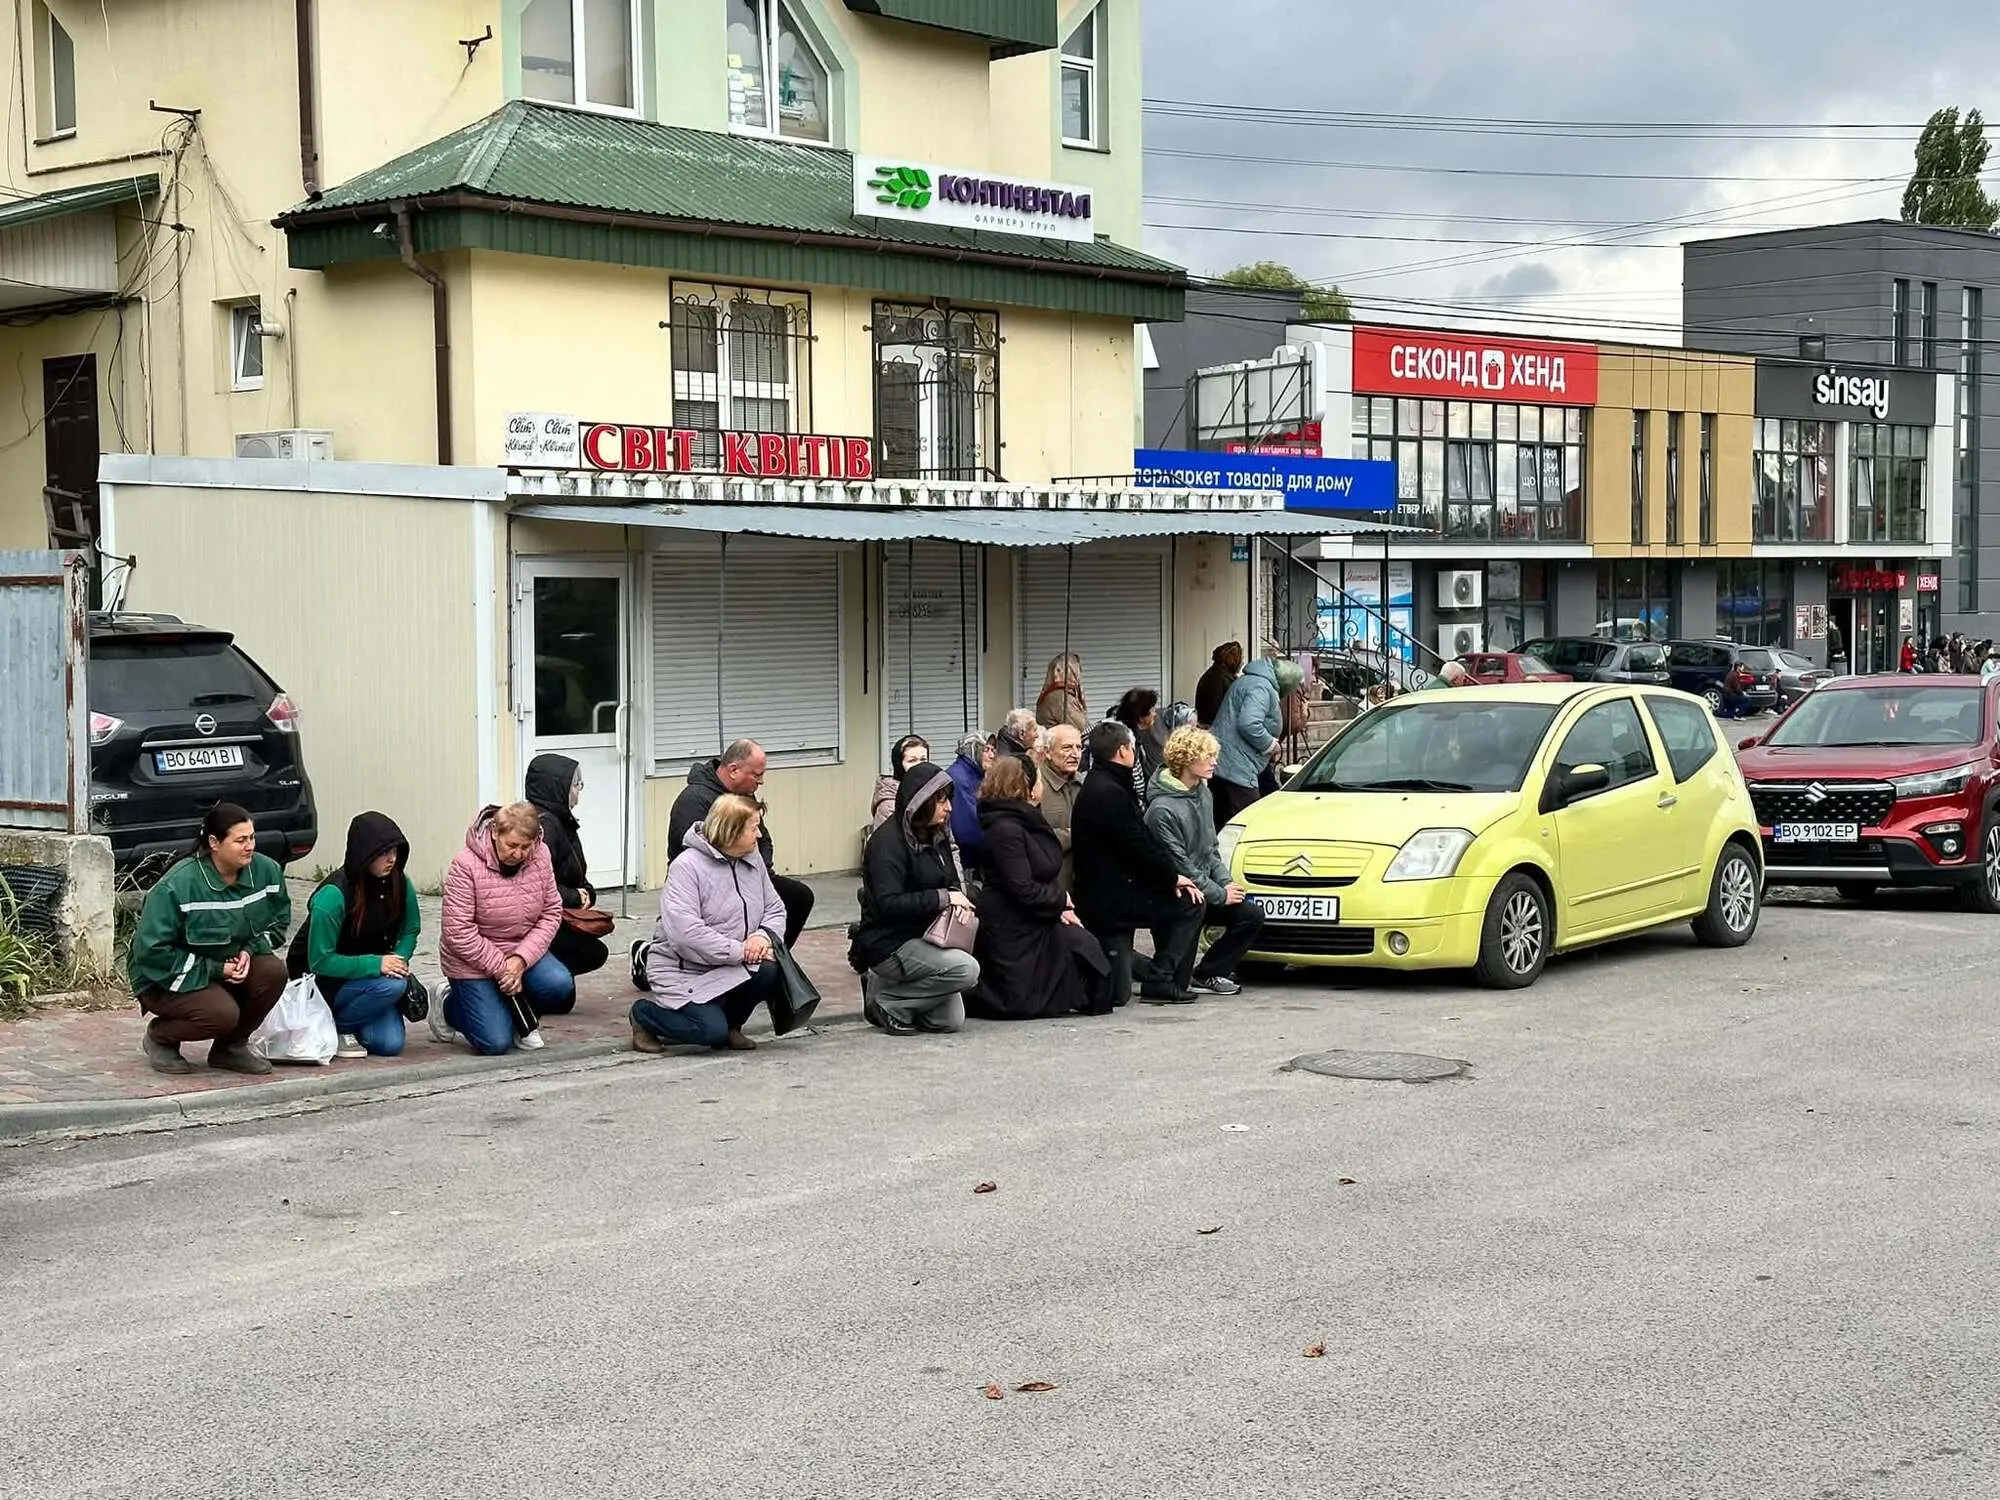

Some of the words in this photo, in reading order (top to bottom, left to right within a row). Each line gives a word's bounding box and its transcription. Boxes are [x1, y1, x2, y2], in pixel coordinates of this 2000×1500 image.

[974, 214, 1024, 228] ФАРМЕРЗ
[1390, 345, 1479, 389] СЕКОНД
[1510, 353, 1567, 394] ХЕНД
[1816, 365, 1890, 419] sinsay
[582, 424, 697, 472] СВІТ
[722, 430, 872, 480] КВІТІВ
[1226, 466, 1284, 489] товарів
[1287, 475, 1313, 491] для
[1315, 475, 1354, 497] дому
[1804, 824, 1833, 837] 9102
